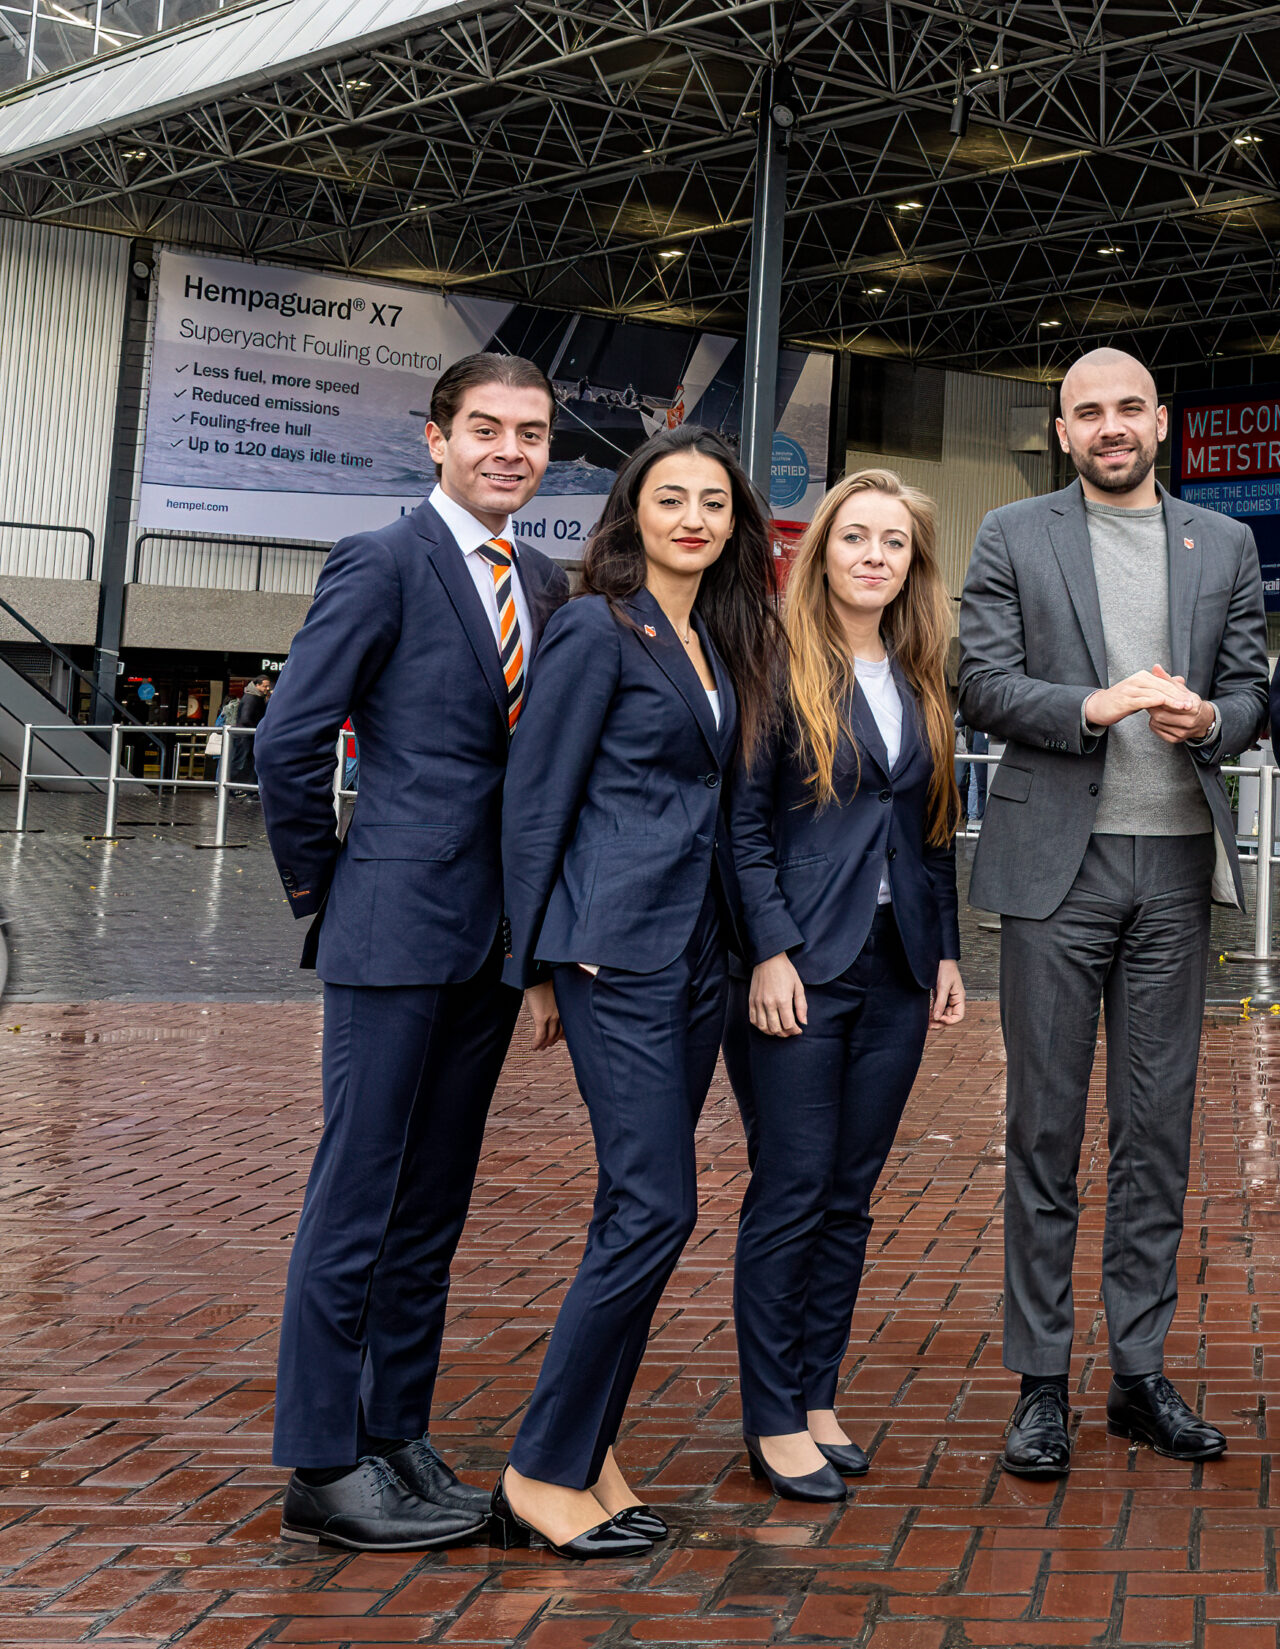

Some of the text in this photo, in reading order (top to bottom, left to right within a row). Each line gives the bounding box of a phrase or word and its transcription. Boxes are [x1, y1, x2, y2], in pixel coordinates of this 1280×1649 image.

[369, 302, 403, 328] X7
[179, 318, 442, 371] Superyacht Fouling Control
[193, 362, 361, 395] Less fuel, more speed
[192, 386, 341, 417] Reduced emissions
[190, 411, 312, 437] Fouling-free hull
[188, 436, 374, 468] Up to 120 days idle time
[771, 465, 807, 477] RIFIED
[166, 499, 229, 512] hempel.com
[1184, 487, 1220, 501] WHERE
[1222, 485, 1243, 499] THE
[1195, 501, 1234, 513] USTRY
[1236, 498, 1271, 513] COMES
[512, 517, 587, 541] and 02.
[262, 659, 287, 671] Par
